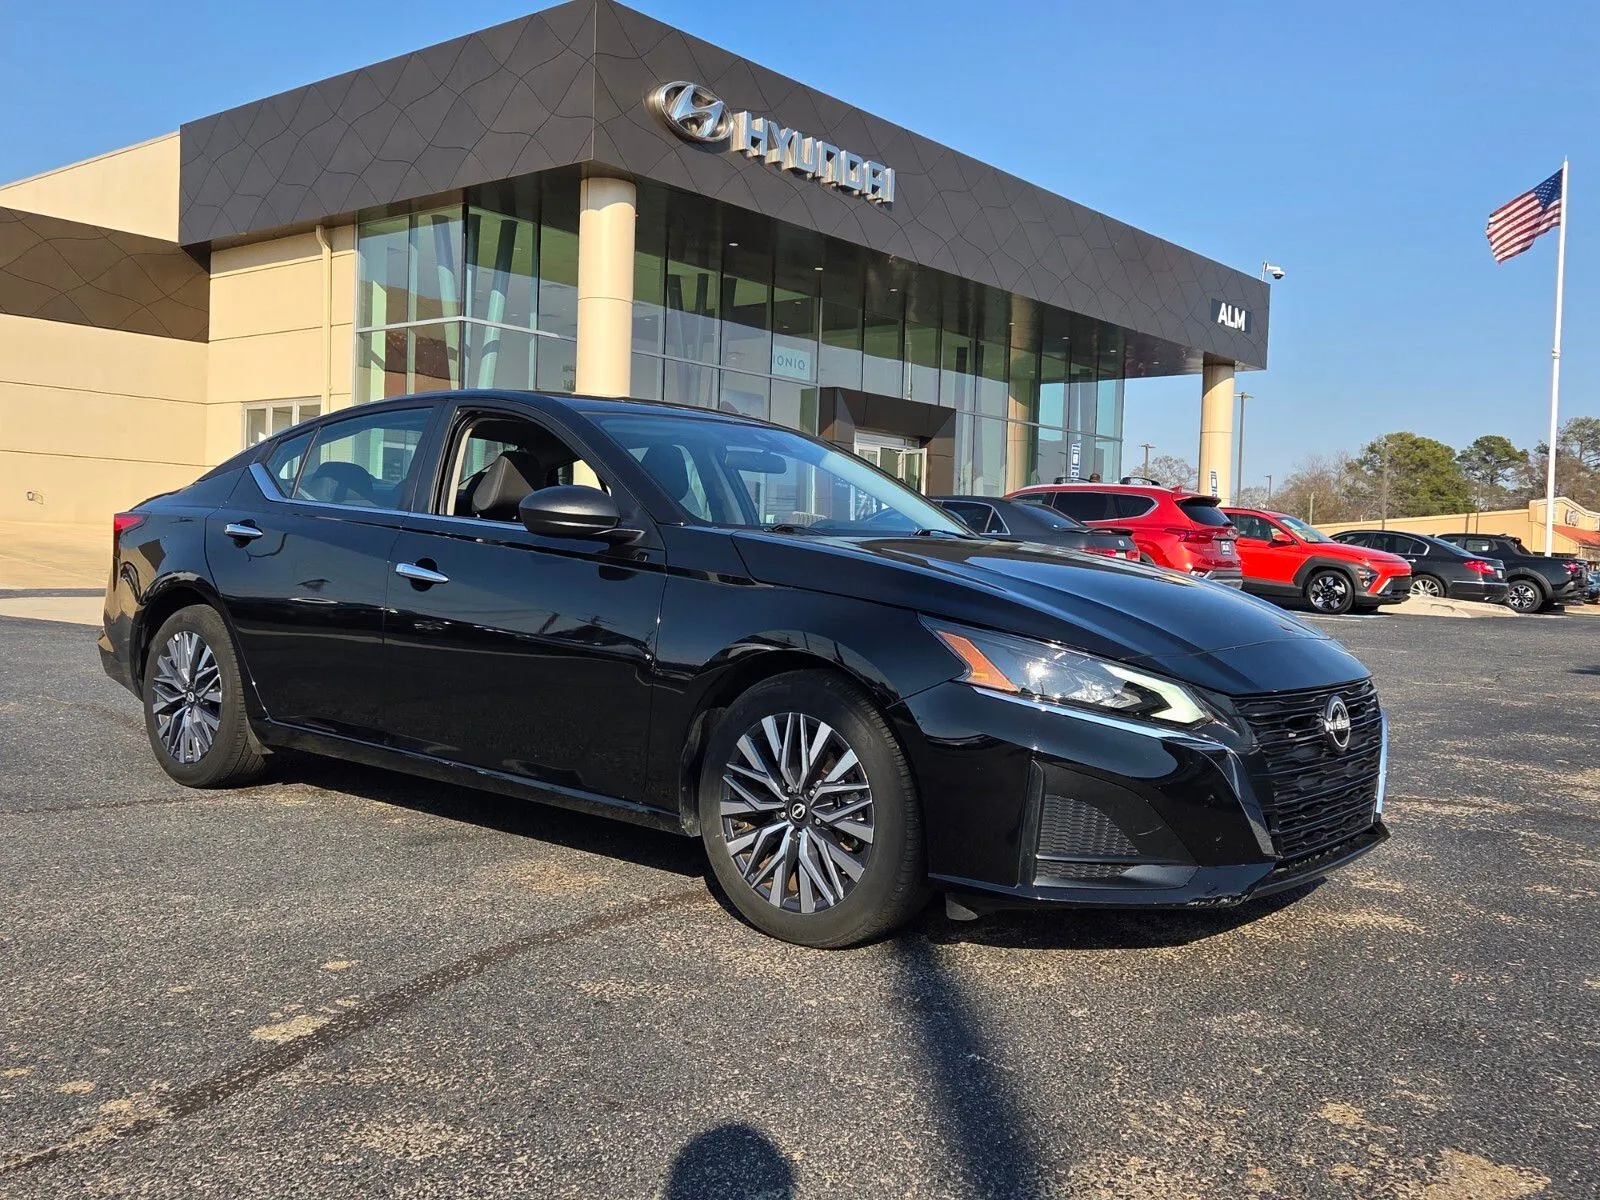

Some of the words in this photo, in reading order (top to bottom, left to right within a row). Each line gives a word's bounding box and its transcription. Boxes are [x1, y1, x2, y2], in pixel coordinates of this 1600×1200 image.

[732, 110, 896, 203] HYUNDAI
[1217, 302, 1246, 332] ALM
[772, 354, 806, 371] IONIQ
[1323, 718, 1351, 732] NISS
